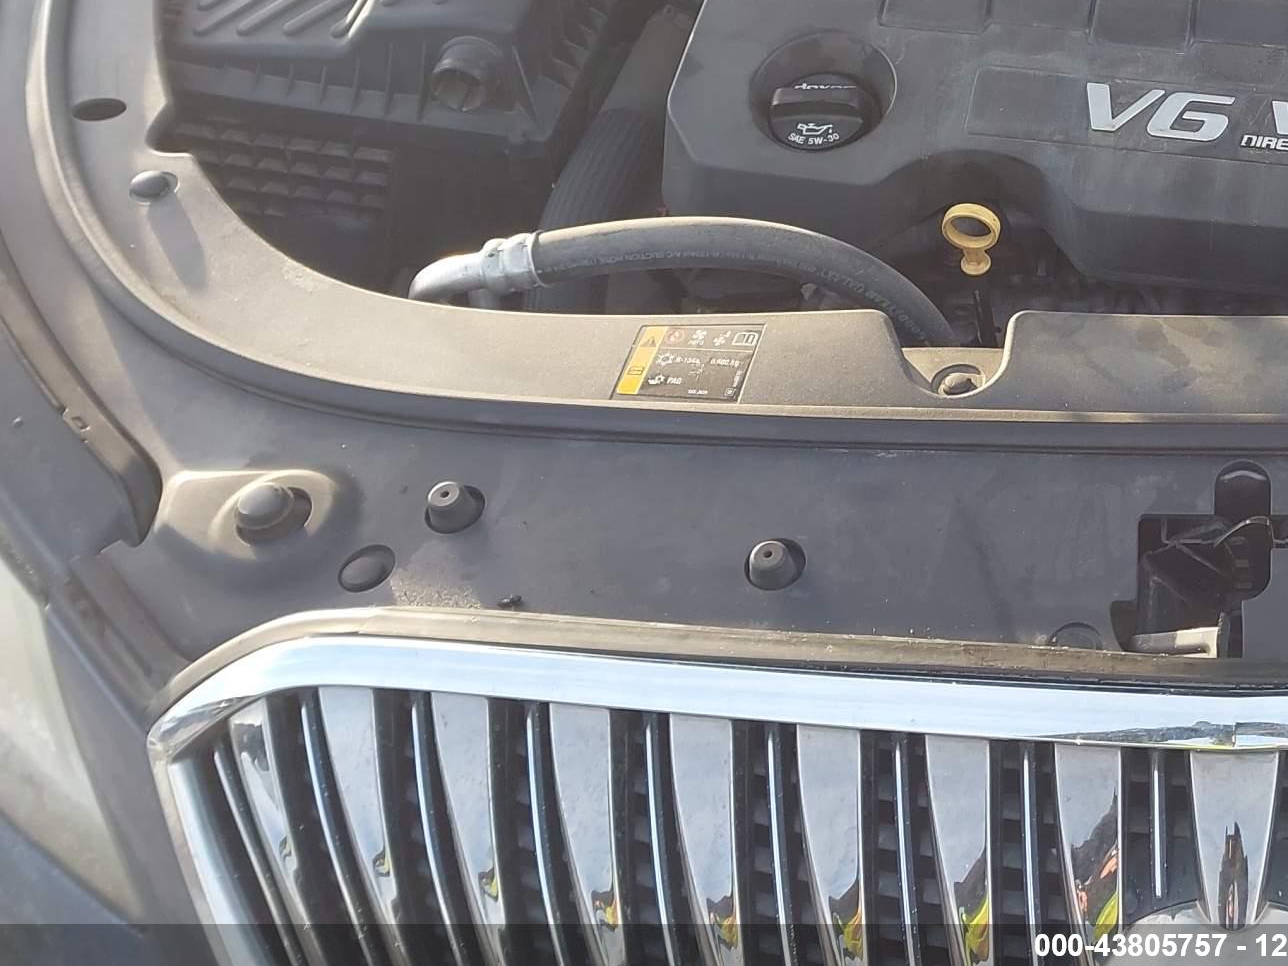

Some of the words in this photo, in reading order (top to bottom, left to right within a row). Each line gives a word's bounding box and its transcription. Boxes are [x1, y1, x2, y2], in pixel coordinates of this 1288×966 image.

[1086, 82, 1235, 141] V6
[788, 133, 805, 144] SAE
[808, 134, 840, 145] 5W-30
